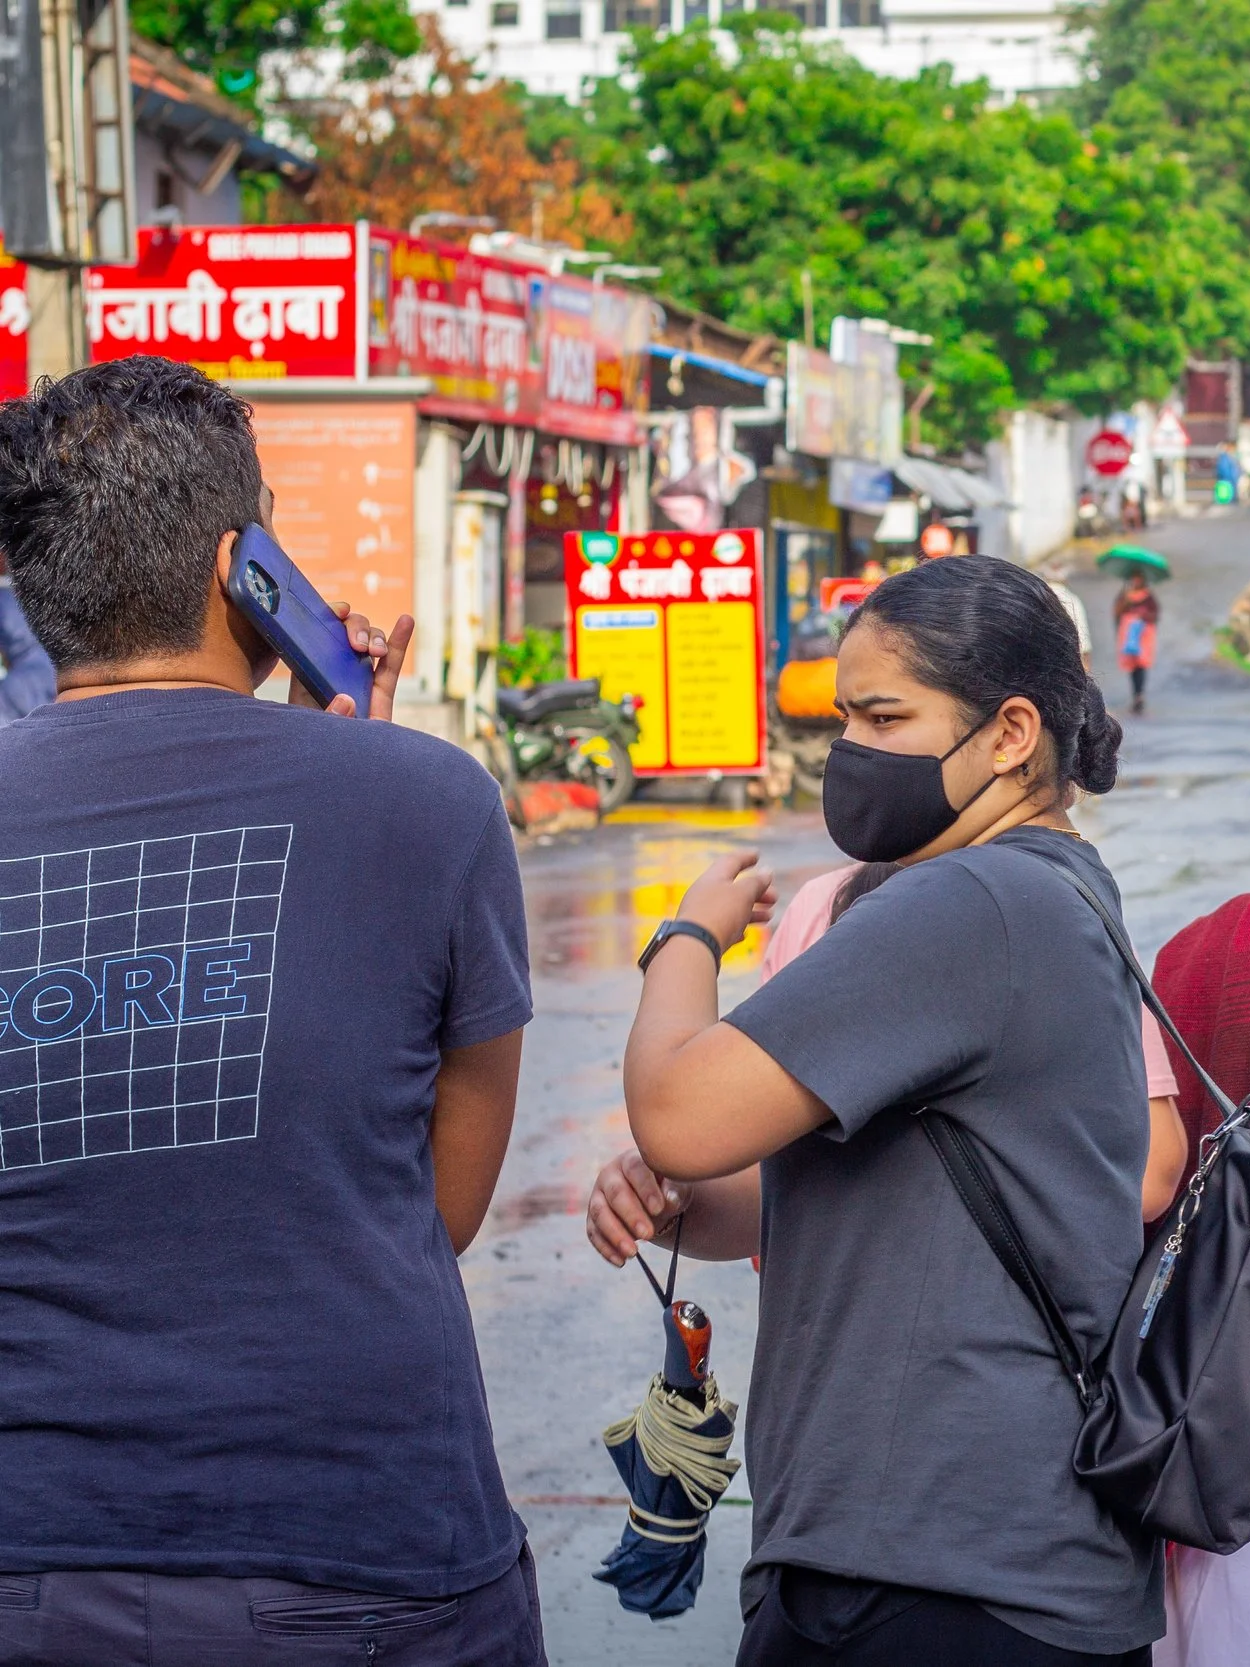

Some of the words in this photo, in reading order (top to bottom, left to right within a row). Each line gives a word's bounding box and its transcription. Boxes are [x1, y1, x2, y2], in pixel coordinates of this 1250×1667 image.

[579, 562, 612, 600] श्री
[618, 559, 694, 599] पंजाबी
[0, 942, 251, 1042] ORE
